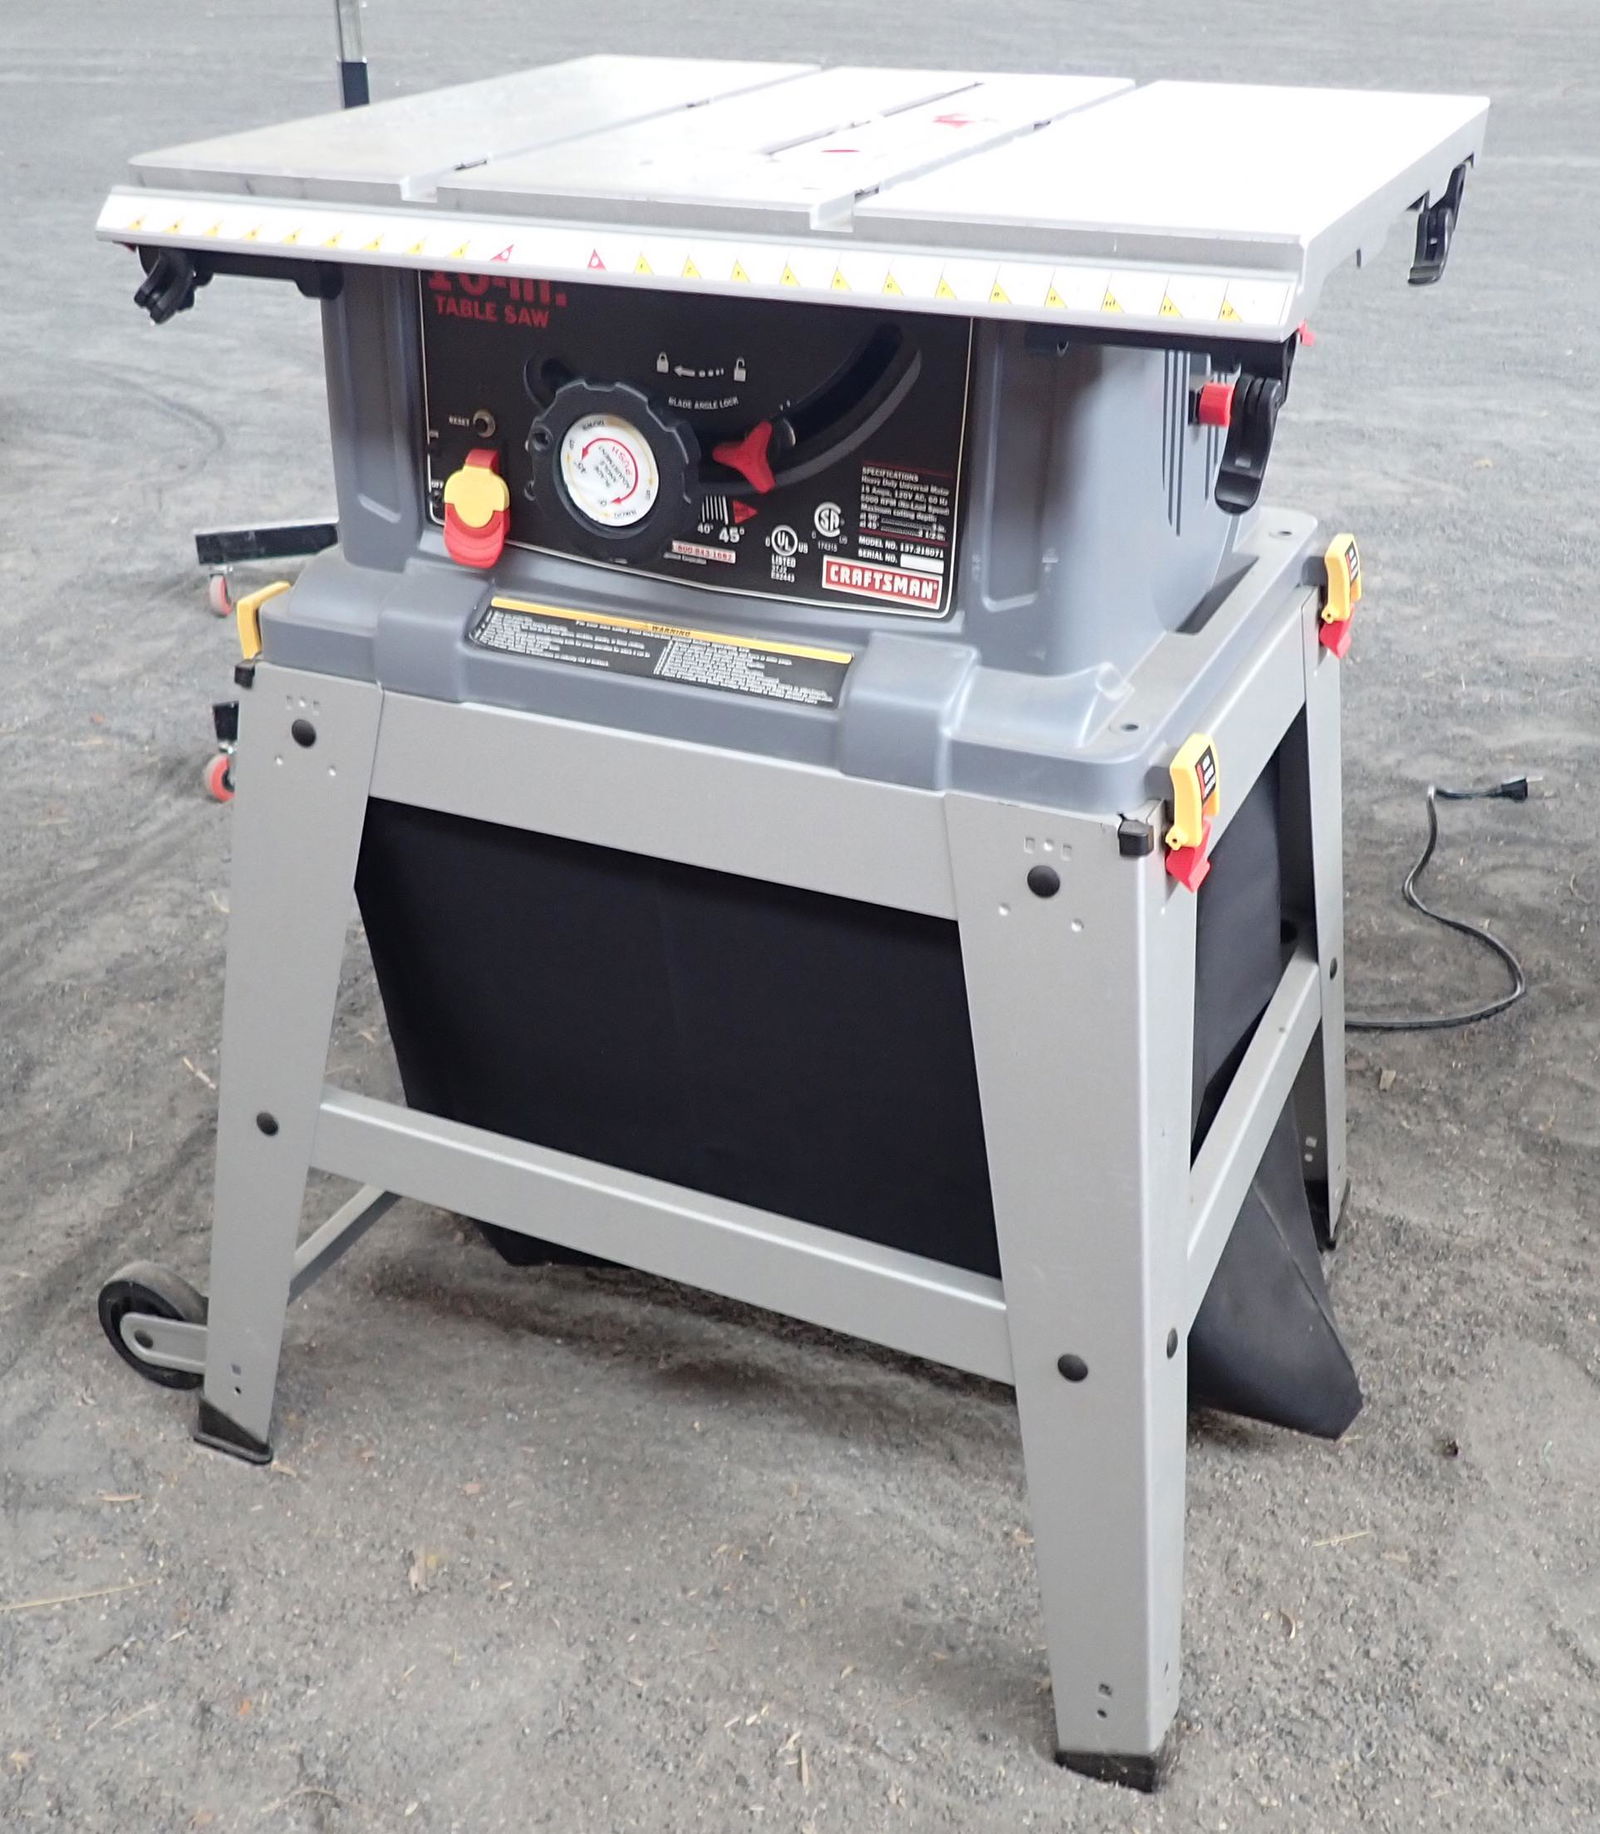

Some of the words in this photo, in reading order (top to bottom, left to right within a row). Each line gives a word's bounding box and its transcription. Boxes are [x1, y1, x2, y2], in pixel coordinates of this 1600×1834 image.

[436, 296, 497, 323] TABLE
[505, 304, 550, 328] SAW
[668, 396, 692, 409] BLADE
[694, 399, 718, 410] ANGLE
[720, 396, 739, 408] LOCK
[449, 416, 470, 427] RESET
[861, 474, 881, 486] Heavy
[882, 478, 898, 489] Duty
[862, 466, 919, 482] SPECIFICATIONS
[880, 496, 897, 507] RPM
[861, 502, 892, 515] Maximum
[893, 508, 916, 521] cutting
[697, 522, 714, 534] 40°
[719, 526, 745, 543] 45°
[858, 535, 883, 548] MODEL
[885, 539, 898, 551] NO.
[771, 553, 796, 569] LISTED
[858, 548, 883, 561] SERIAL
[885, 553, 898, 563] NO.
[652, 625, 691, 637] WARNING
